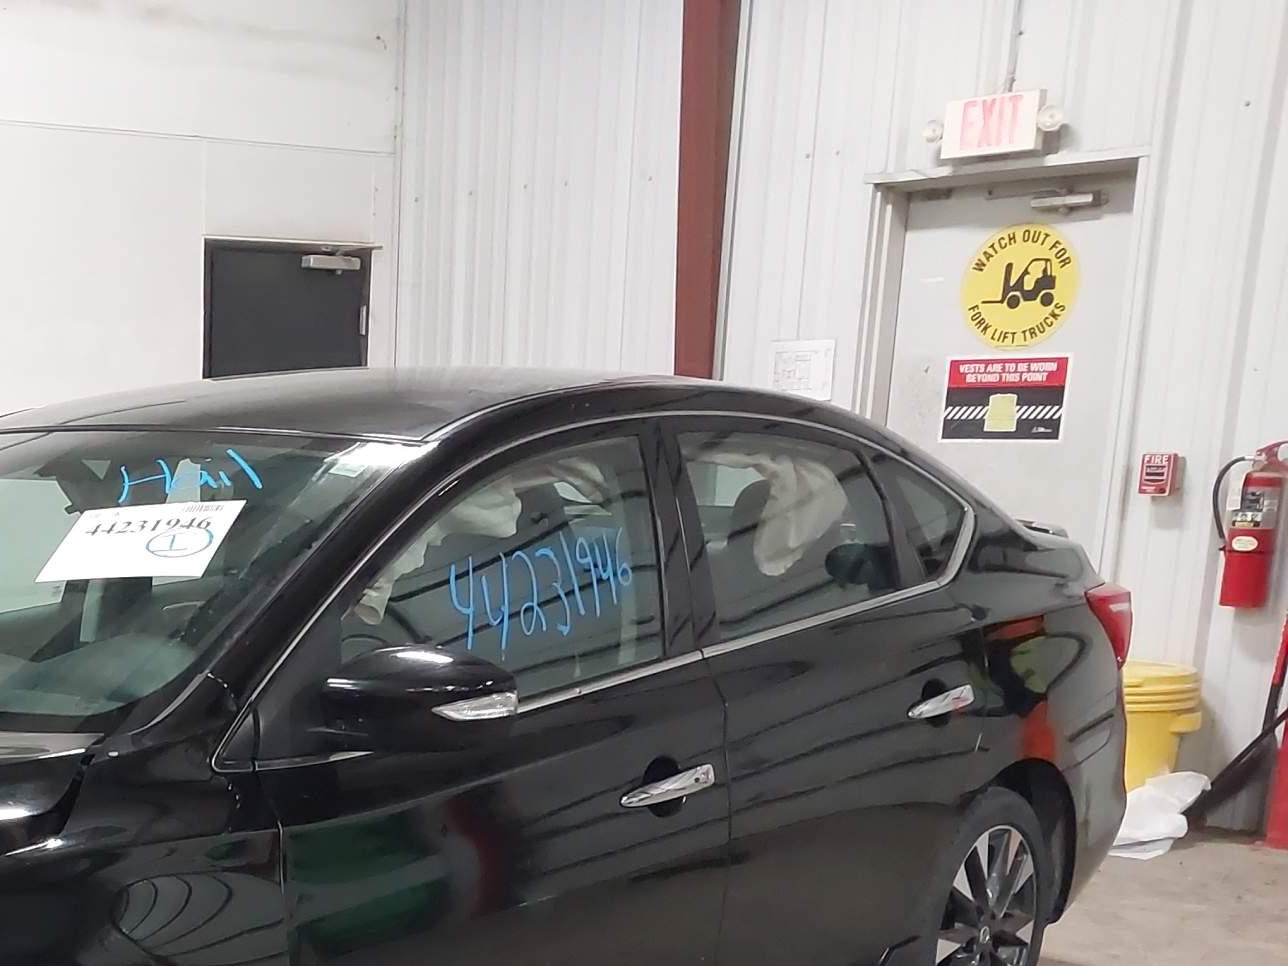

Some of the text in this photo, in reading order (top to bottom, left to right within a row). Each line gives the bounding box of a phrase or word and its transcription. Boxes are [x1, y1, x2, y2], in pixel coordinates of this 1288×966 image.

[960, 95, 1024, 149] EXIT
[972, 229, 1072, 272] WATCH OUT FOR
[968, 302, 1066, 344] FORK LIFT TRUCKS
[959, 363, 985, 373] VESTS
[986, 363, 1004, 373] ARE
[1004, 362, 1016, 372] TO
[1017, 362, 1029, 372] BE
[965, 372, 1048, 383] BEYOND THIS POINT
[1143, 454, 1169, 465] FIRE
[84, 516, 212, 537] 44231946
[449, 527, 633, 662] 44231946
